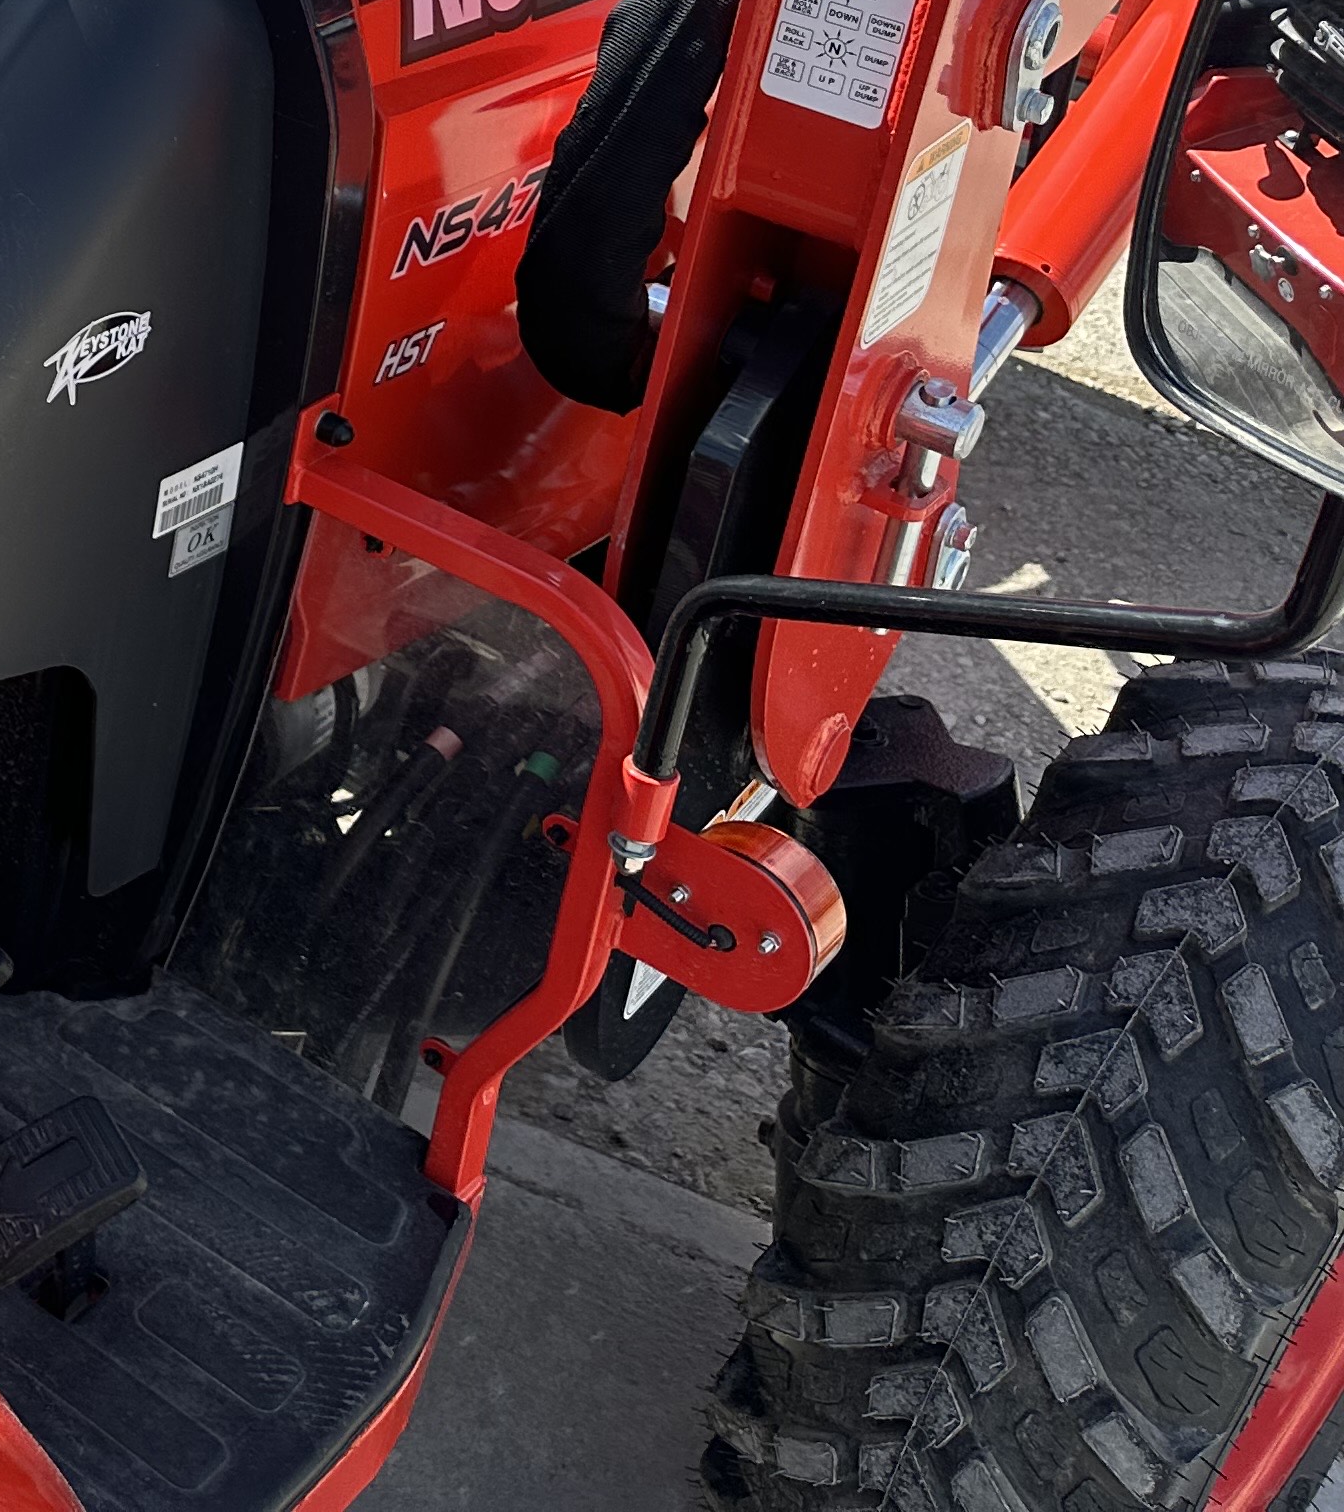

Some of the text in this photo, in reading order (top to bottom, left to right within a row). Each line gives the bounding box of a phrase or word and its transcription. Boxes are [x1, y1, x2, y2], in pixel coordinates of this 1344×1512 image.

[829, 8, 860, 25] DOWN
[784, 26, 806, 38] ROLL
[872, 28, 897, 39] DUMP
[782, 34, 805, 47] BACK
[828, 41, 842, 56] N
[864, 54, 889, 67] DUMP
[854, 91, 879, 103] DUMP
[374, 320, 447, 385] HST
[187, 522, 220, 553] OK
